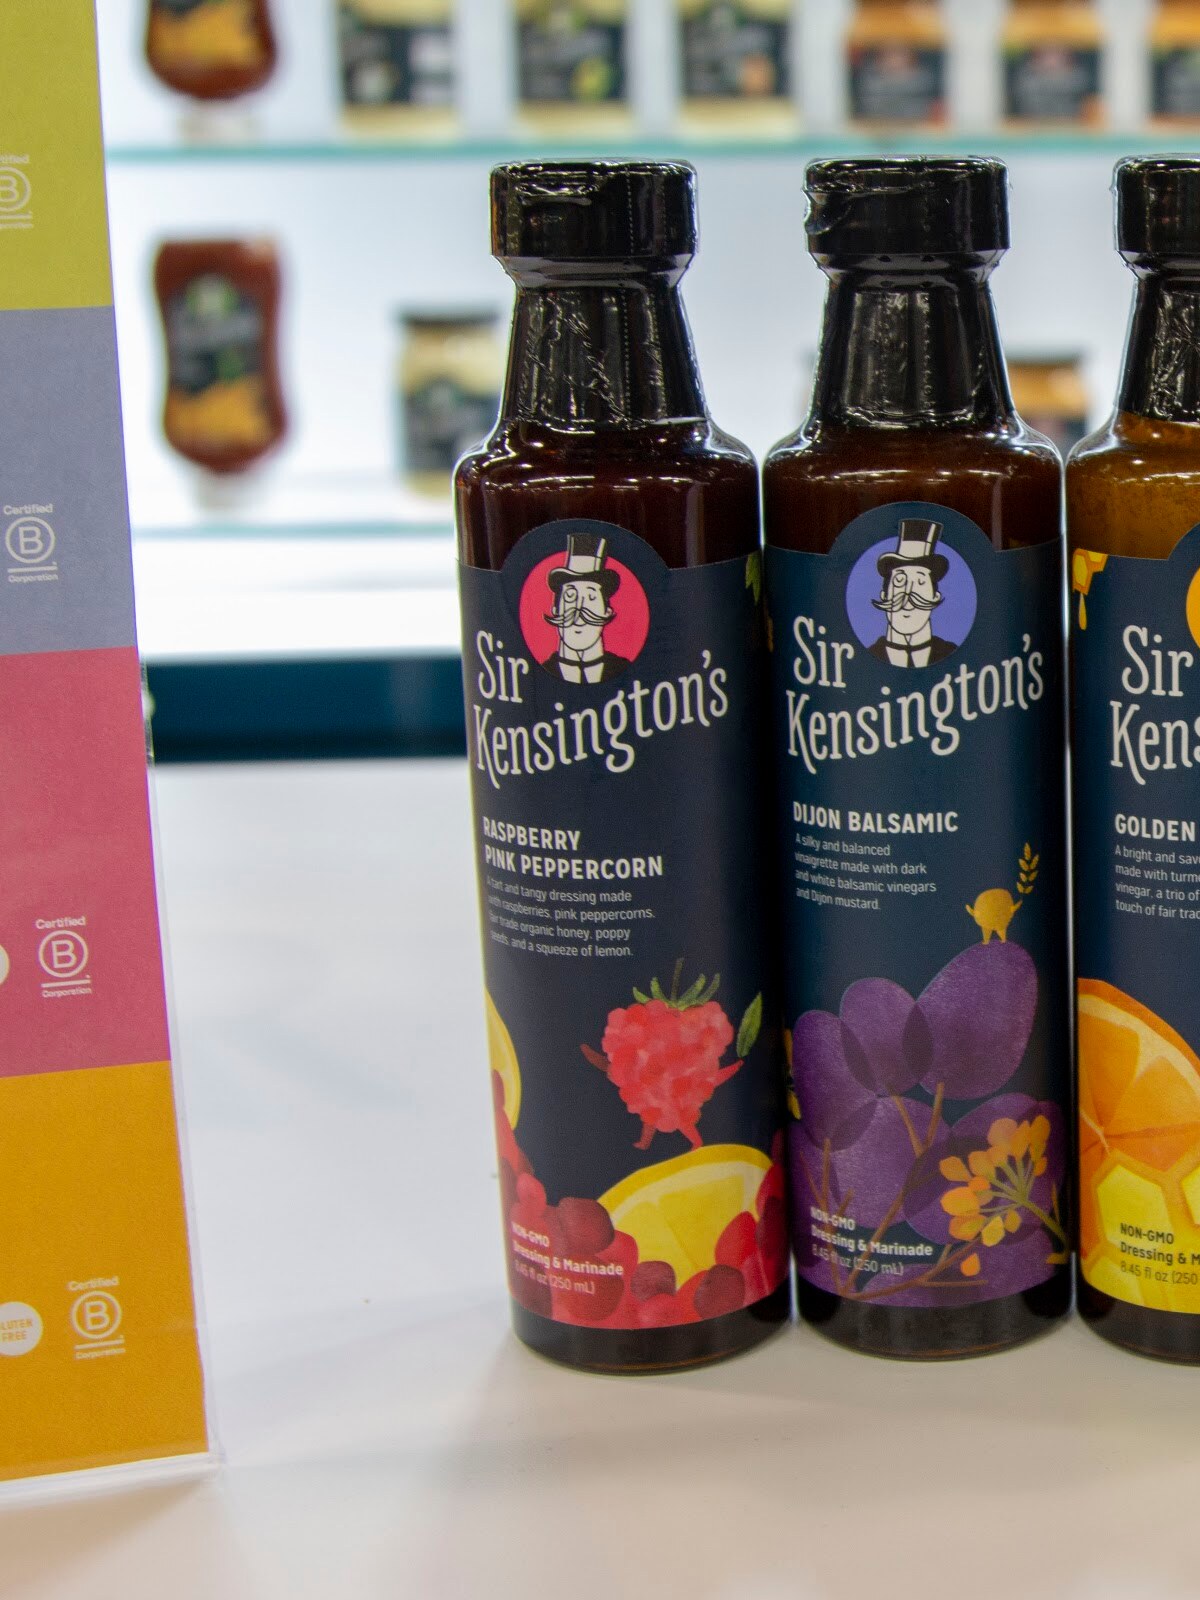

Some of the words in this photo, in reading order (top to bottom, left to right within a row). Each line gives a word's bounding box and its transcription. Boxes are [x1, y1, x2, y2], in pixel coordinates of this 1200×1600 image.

[3, 503, 54, 515] Certified
[8, 573, 59, 583] Corporation
[793, 615, 855, 688] Sir
[1121, 624, 1194, 697] Sir
[476, 629, 529, 704] Sir
[786, 633, 1044, 775] Kensington's
[473, 649, 729, 790] Kensington's
[793, 801, 841, 830] DIJON
[848, 810, 959, 834] BALSAMIC
[1114, 813, 1196, 842] GOLDEN
[482, 816, 581, 851] RASPBERRY
[795, 833, 801, 843] A
[802, 835, 821, 851] silky
[822, 840, 840, 852] and
[842, 841, 891, 856] balanced
[484, 844, 517, 873] PINK
[520, 854, 663, 880] PEPPERCORN
[795, 851, 838, 870] vinaigrette
[840, 861, 870, 873] made
[872, 862, 898, 874] with
[901, 863, 927, 875] dark
[1114, 844, 1122, 856] A
[1123, 846, 1153, 863] bright
[1155, 852, 1176, 864] and
[795, 869, 810, 882] and
[809, 874, 836, 887] white
[837, 877, 885, 892] balsamic
[887, 882, 937, 895] vinegars
[1115, 864, 1141, 878] made
[1144, 868, 1168, 881] with
[504, 883, 520, 896] and
[521, 886, 548, 902] tangy
[549, 889, 597, 905] dressing
[599, 890, 633, 902] made
[796, 887, 810, 900] and
[811, 890, 834, 906] Dijon
[835, 896, 881, 910] mustard.
[1156, 889, 1163, 899] a
[1165, 889, 1185, 900] trio
[1188, 890, 1200, 901] of
[554, 908, 577, 921] pink
[1115, 899, 1143, 914] touch
[1144, 904, 1156, 916] of
[1158, 905, 1177, 918] fair
[36, 916, 86, 929] Certified
[520, 922, 554, 937] organic
[595, 927, 631, 941] poppy
[511, 938, 526, 950] and
[528, 942, 535, 951] a
[536, 943, 579, 957] squeeze
[581, 945, 594, 956] of
[595, 945, 634, 957] lemon.
[42, 987, 92, 998] Corporation
[810, 1206, 856, 1231] NON-GMO
[811, 1224, 855, 1252] Dressing
[857, 1239, 867, 1252] &
[870, 1240, 934, 1256] Marinade
[1120, 1223, 1174, 1245] NON-GMO
[1120, 1242, 1174, 1266] Dressing
[1177, 1253, 1187, 1265] &
[553, 1256, 561, 1269] &
[563, 1258, 624, 1276] Marinade
[839, 1256, 851, 1267] oz
[853, 1256, 878, 1273] (250
[881, 1262, 904, 1276] mL)
[1120, 1261, 1142, 1277] 8.45
[1144, 1267, 1151, 1279] fl
[1155, 1271, 1168, 1283] oz
[1172, 1270, 1198, 1286] (250
[537, 1274, 549, 1286] oz
[549, 1274, 572, 1291] (250
[574, 1282, 595, 1296] mL)
[0, 1319, 33, 1331] LUTEN
